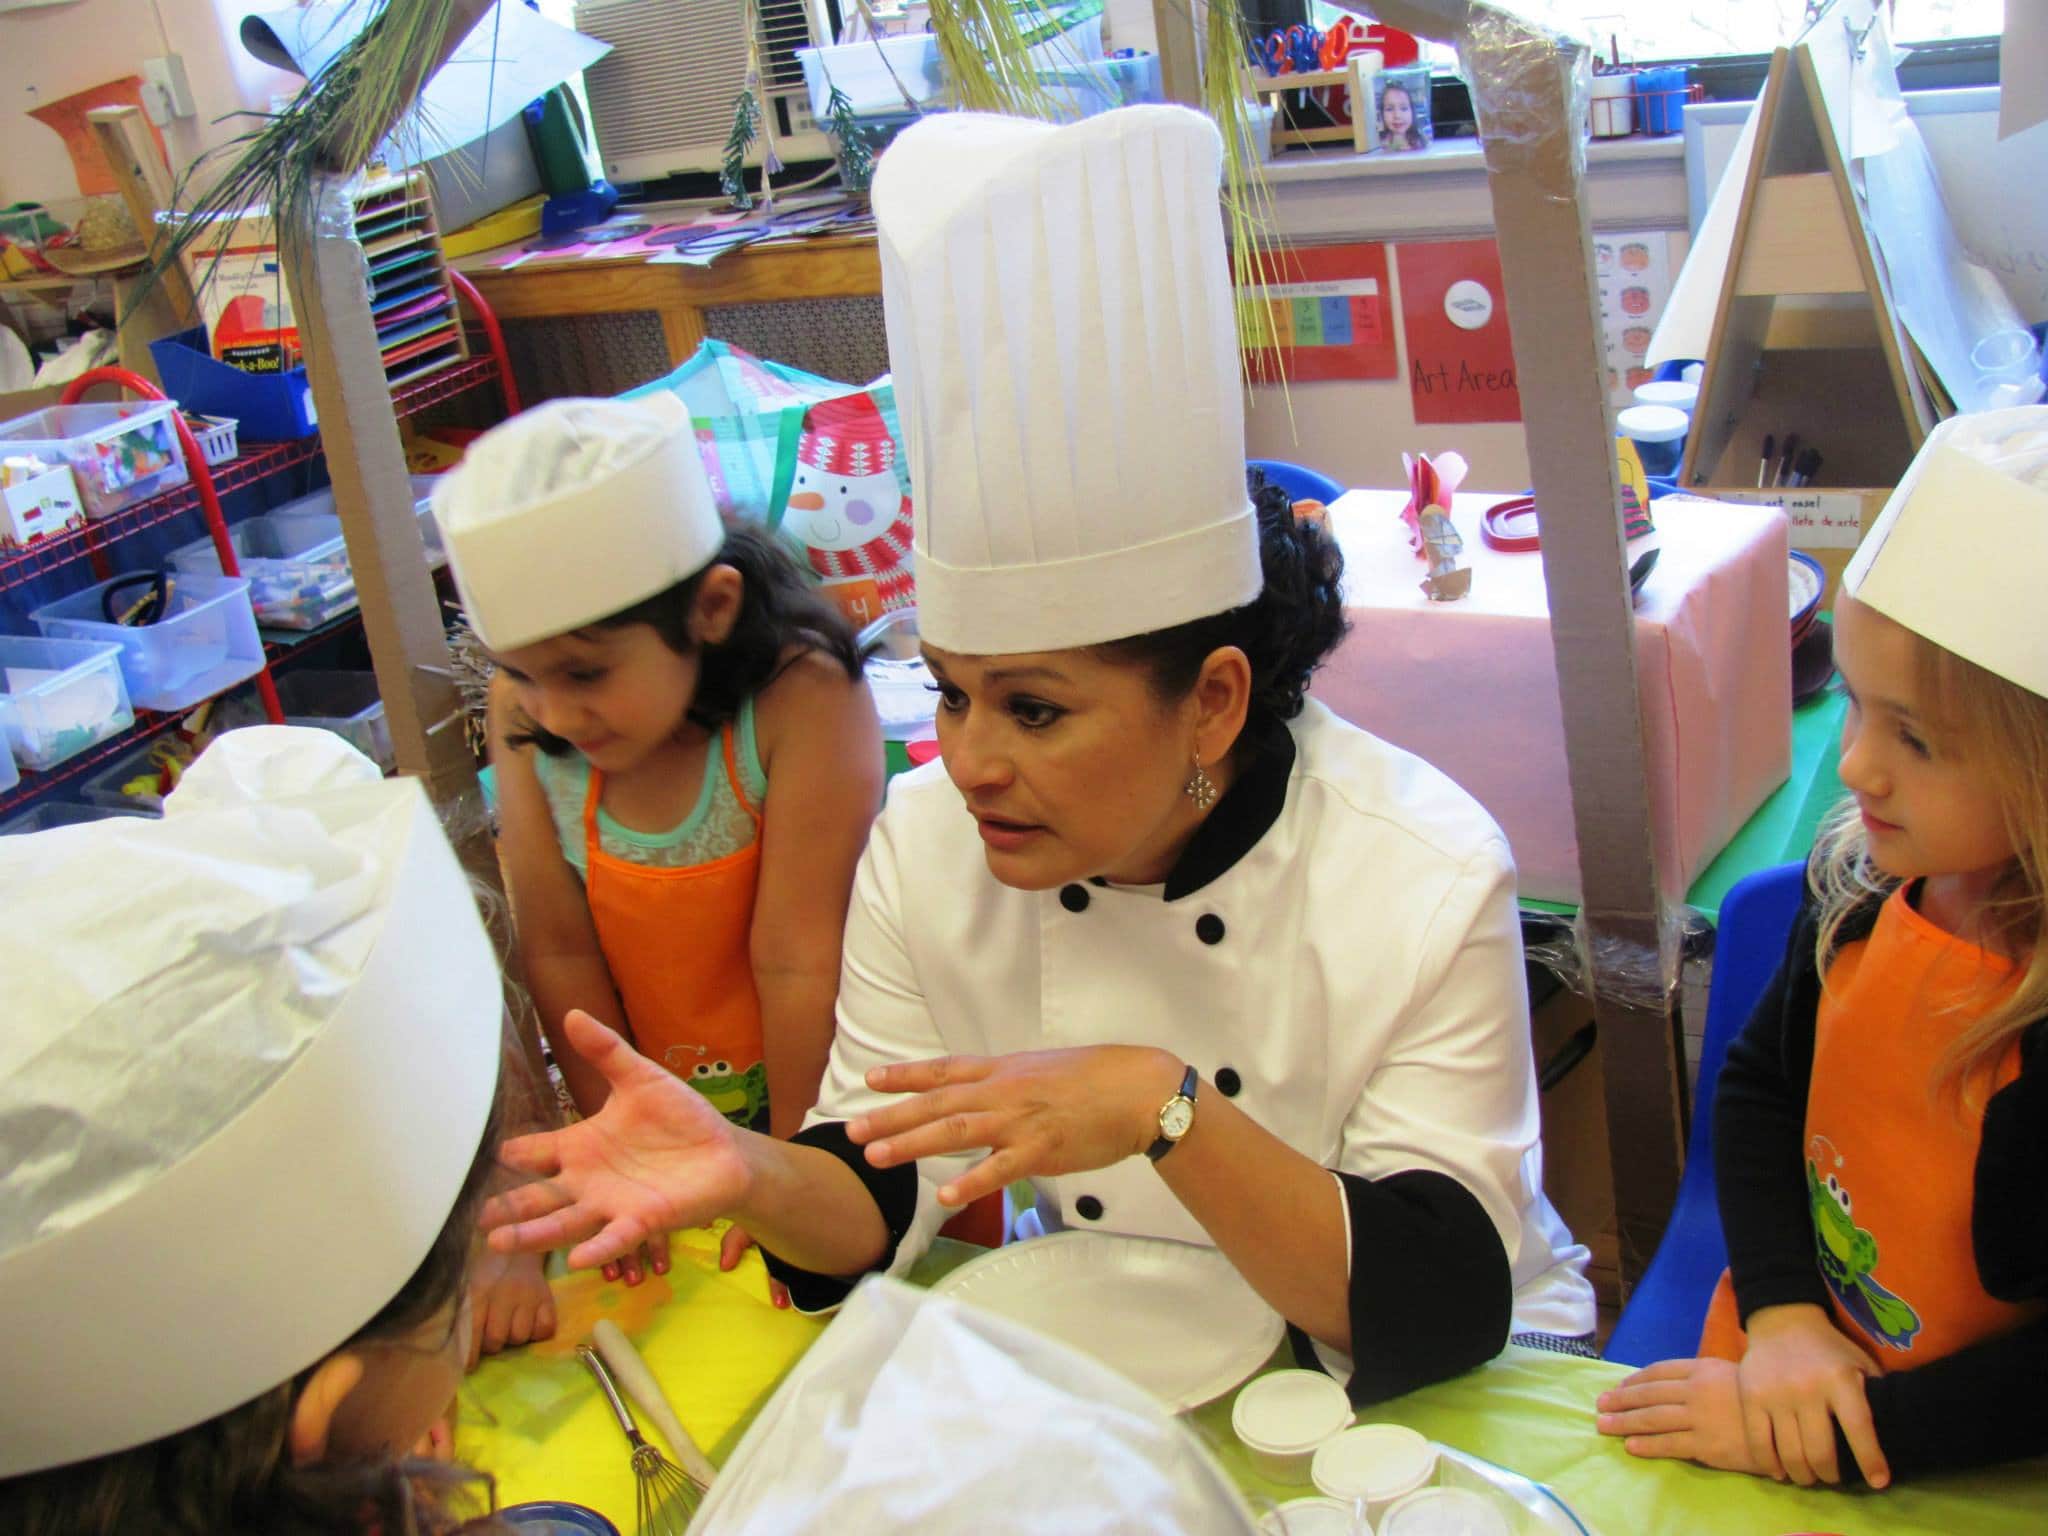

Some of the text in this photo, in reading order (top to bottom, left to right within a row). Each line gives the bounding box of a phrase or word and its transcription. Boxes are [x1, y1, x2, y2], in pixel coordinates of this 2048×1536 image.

[1414, 359, 1519, 394] Art Area
[1792, 496, 1821, 509] easel
[1791, 515, 1860, 528] llete de arte
